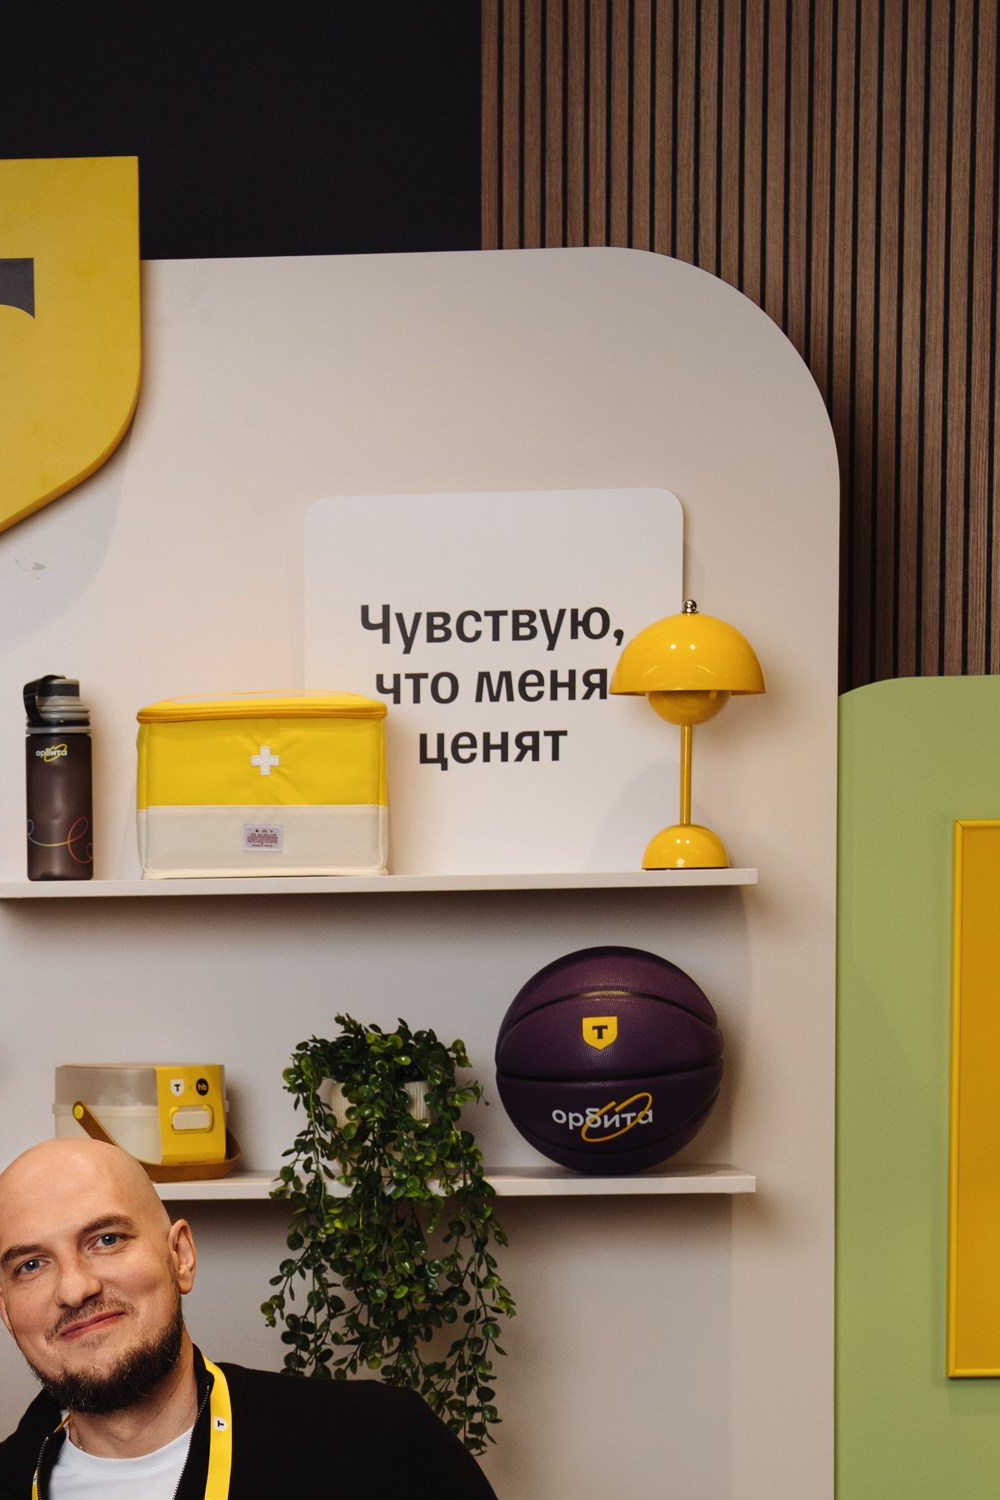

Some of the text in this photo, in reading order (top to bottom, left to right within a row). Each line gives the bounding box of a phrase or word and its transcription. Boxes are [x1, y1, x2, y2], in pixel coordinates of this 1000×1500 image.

[360, 604, 625, 655] Чувствую,
[375, 668, 608, 705] что меня
[419, 729, 568, 771] ценят
[551, 1105, 654, 1132] орбита
